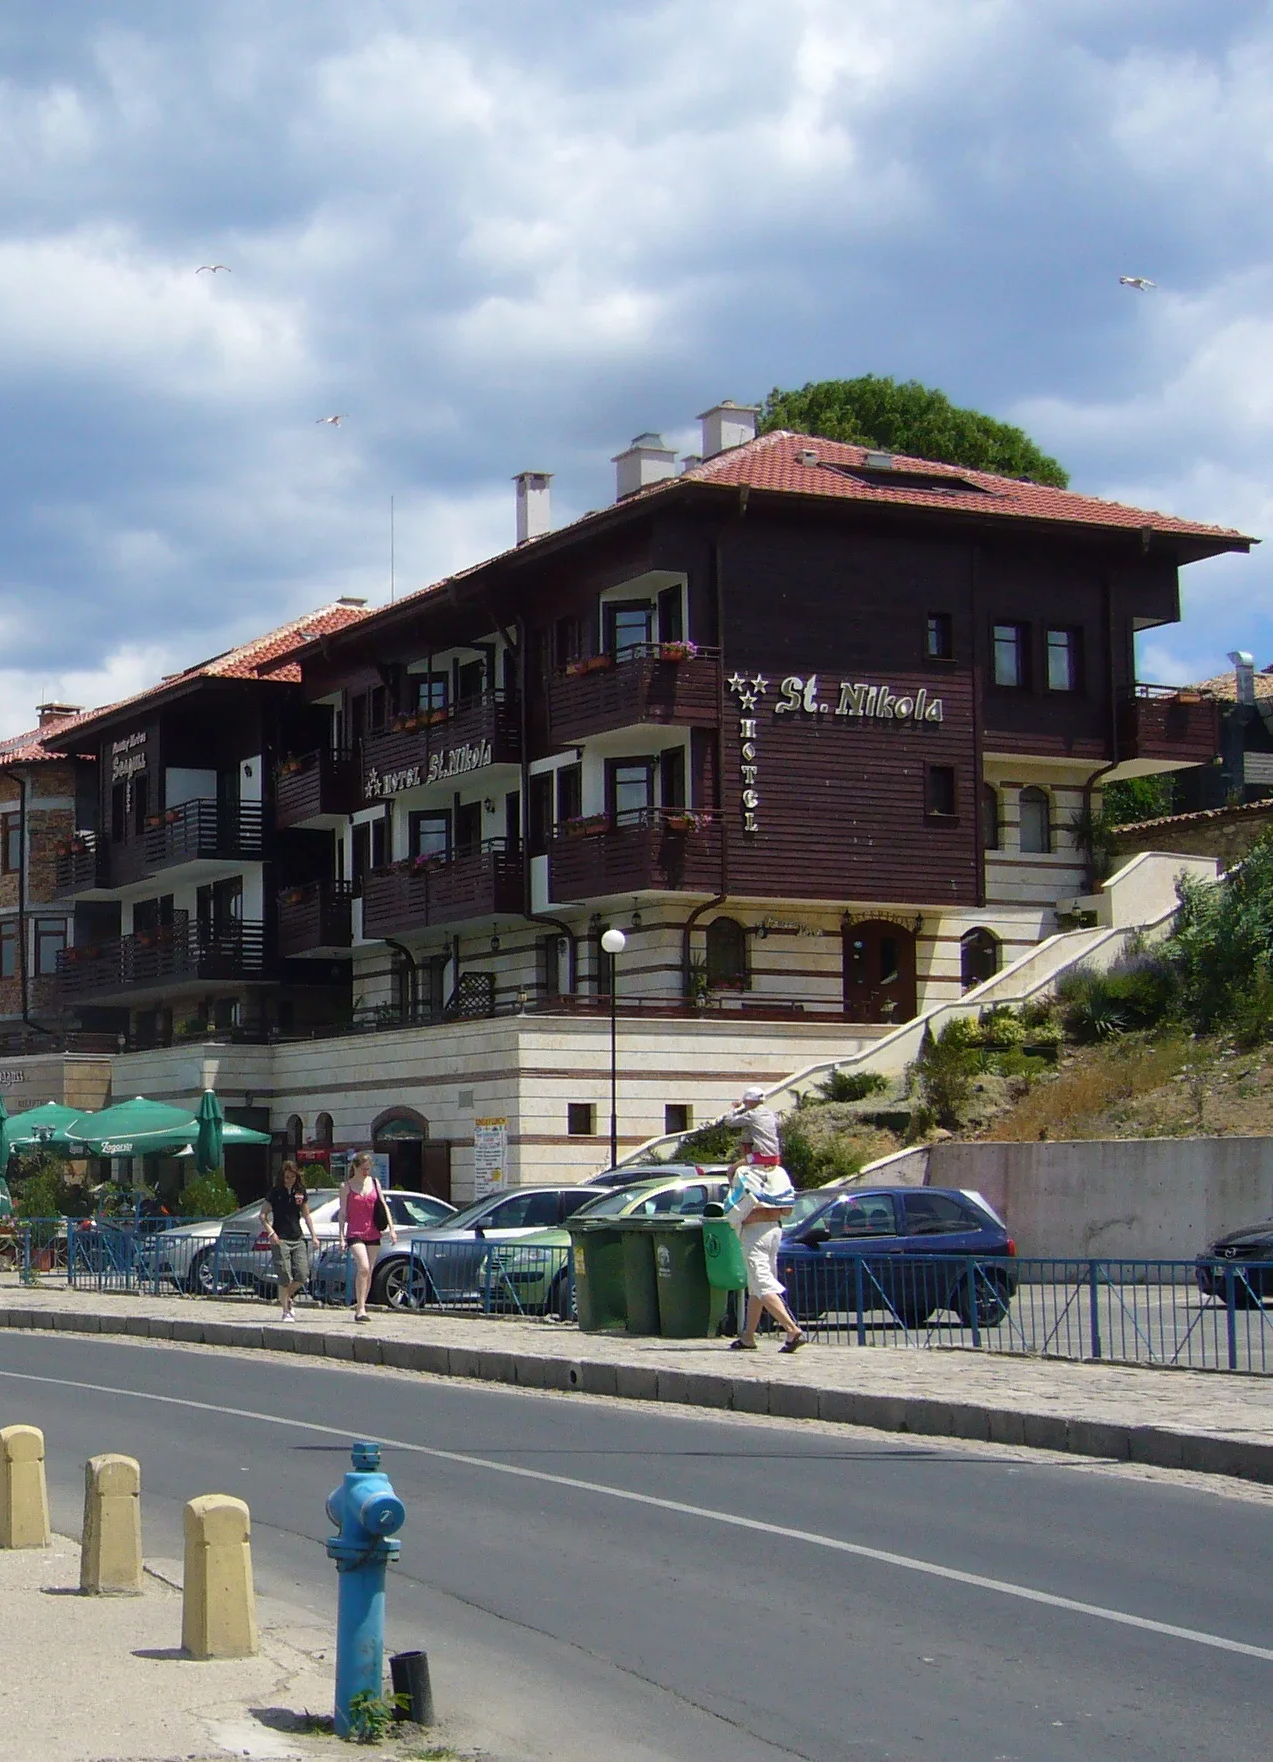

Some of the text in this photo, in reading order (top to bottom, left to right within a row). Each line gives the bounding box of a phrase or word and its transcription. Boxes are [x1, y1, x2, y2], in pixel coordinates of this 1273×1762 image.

[775, 674, 944, 722] St. Nikola
[382, 766, 421, 795] HOTEL
[739, 719, 759, 832] HOTEL
